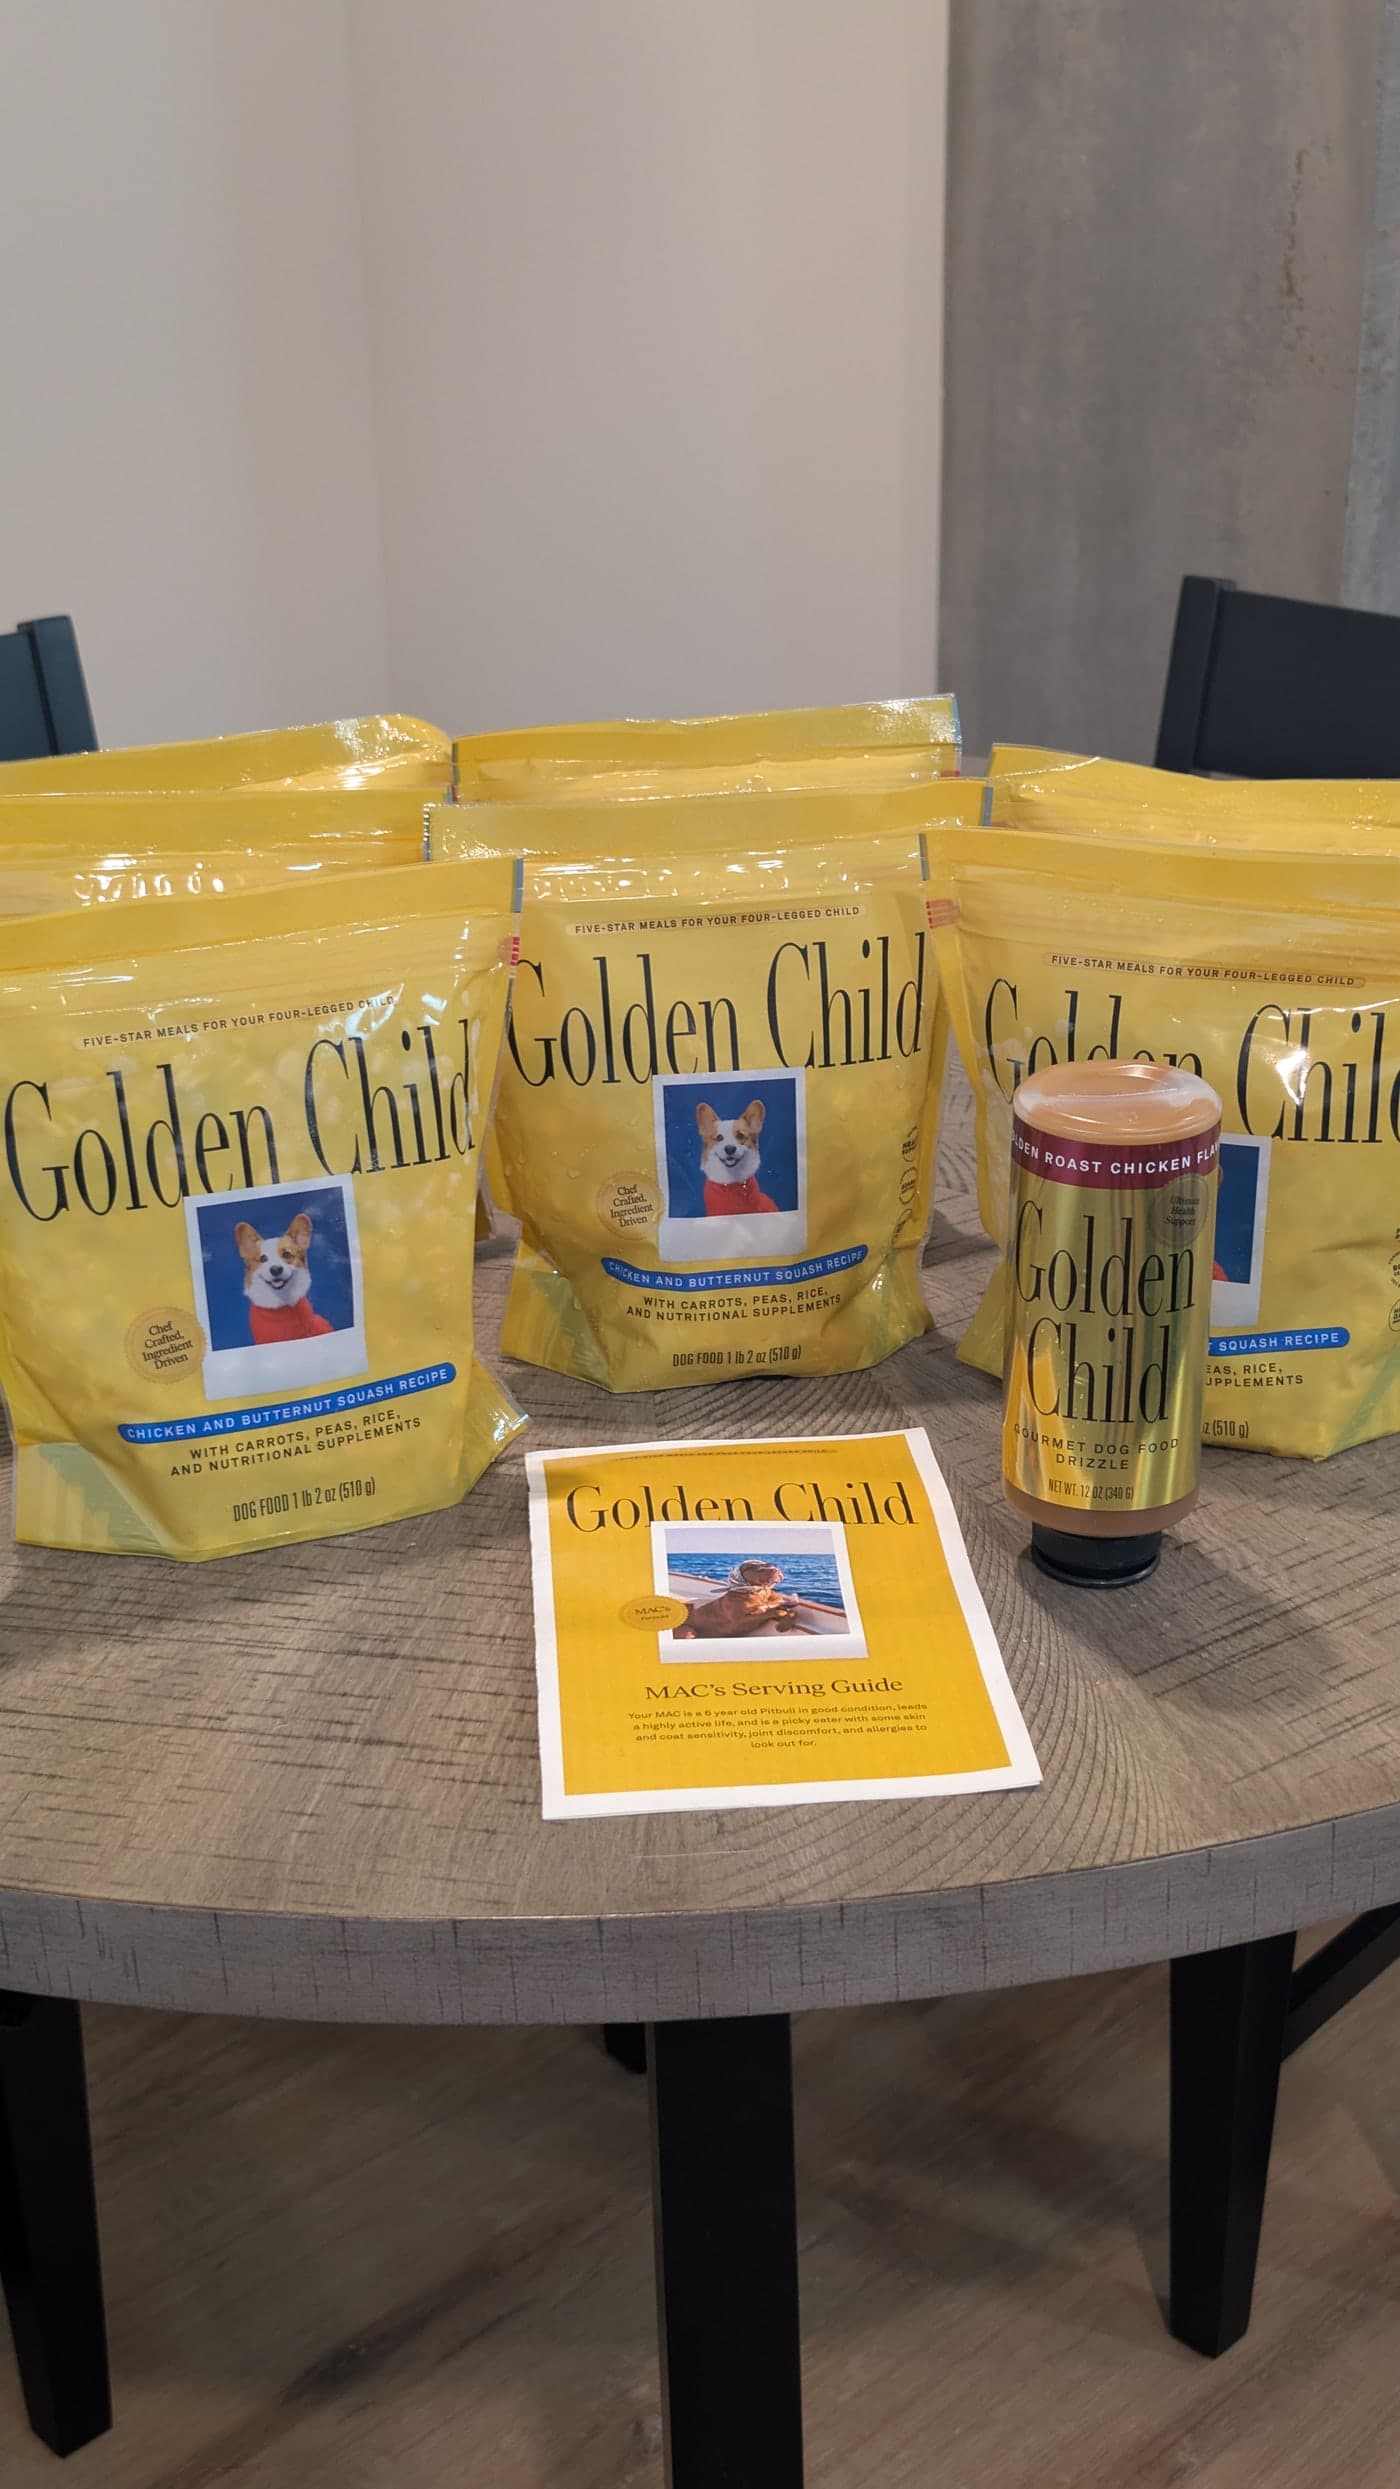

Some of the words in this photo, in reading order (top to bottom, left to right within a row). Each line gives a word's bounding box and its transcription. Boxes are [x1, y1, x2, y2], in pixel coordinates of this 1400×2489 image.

[576, 922, 635, 934] FIVE-STAR
[640, 920, 677, 929] MEALS
[682, 918, 702, 926] FOR
[707, 915, 736, 925] YOUR
[741, 910, 820, 922] FOUR-LEGGED
[826, 906, 859, 916] CHILD
[1052, 955, 1112, 969] FIVE-STAR
[1118, 962, 1154, 973] MEALS
[1160, 966, 1182, 976] FOR
[1188, 968, 1219, 978] YOUR
[1224, 970, 1312, 983] FOUR-LEGGED
[1317, 976, 1354, 985] CHILD
[507, 954, 739, 1086] Golden
[767, 932, 925, 1069] Child
[83, 1030, 152, 1047] FIVE-STAR
[157, 1024, 198, 1037] MEALS
[203, 1020, 226, 1031] FOR
[231, 1015, 264, 1027] YOUR
[269, 1003, 353, 1022] FOUR-LEGGED
[1237, 1004, 1400, 1143] Chil
[5, 1064, 280, 1221] Golden
[305, 1019, 475, 1175] Child
[1013, 1133, 1039, 1159] LDEN
[1045, 1152, 1101, 1173] ROAST
[1111, 1157, 1191, 1174] CHICKEN
[618, 1184, 637, 1195] Chef
[610, 1204, 653, 1218] Ingredient
[619, 1216, 647, 1227] Driven
[609, 1262, 649, 1283] CHICKEN
[656, 1276, 683, 1287] AND
[689, 1272, 769, 1287] BUTTERNUT
[776, 1263, 823, 1280] SQUASH
[827, 1250, 863, 1268] RECIPE
[1016, 1201, 1195, 1316] Golden
[627, 1306, 650, 1318] AND
[657, 1309, 747, 1322] NUTRITIONAL
[753, 1294, 841, 1317] SUPPLEMENTS
[644, 1296, 675, 1309] WITH
[682, 1297, 747, 1309] CARROTS,
[753, 1294, 791, 1305] PEAS,
[798, 1287, 827, 1300] RICE,
[149, 1321, 172, 1335] Chef
[142, 1340, 193, 1361] Ingredient
[1219, 1337, 1277, 1351] SQUASH
[1285, 1333, 1339, 1345] RECIPE
[154, 1354, 188, 1369] Driven
[673, 1353, 693, 1367] DOG
[697, 1352, 722, 1364] FOOD
[727, 1351, 732, 1363] 1
[735, 1351, 744, 1363] lb
[747, 1351, 753, 1363] 2
[756, 1354, 766, 1363] oz
[769, 1347, 789, 1363] (510
[792, 1345, 801, 1360] g)
[1028, 1317, 1169, 1423] Child
[1206, 1365, 1236, 1376] EAS,
[1243, 1363, 1282, 1374] RICE,
[1206, 1375, 1303, 1387] UPPLEMENTS
[128, 1424, 196, 1439] CHICKEN
[203, 1418, 234, 1431] AND
[242, 1400, 332, 1424] BUTTERNUT
[337, 1384, 393, 1406] SQUASH
[400, 1369, 447, 1390] RECIPE
[191, 1446, 229, 1459] WITH
[236, 1431, 310, 1453] CARROTS,
[316, 1420, 357, 1437] PEAS,
[364, 1409, 400, 1425] RICE,
[1015, 1424, 1085, 1452] GOURMET
[1095, 1444, 1129, 1454] DOG
[1138, 1439, 1178, 1453] FOOD
[1213, 1420, 1235, 1436] (510
[1239, 1421, 1248, 1438] g)
[171, 1464, 202, 1476] AND
[210, 1445, 311, 1471] NUTRITIONAL
[318, 1417, 421, 1451] SUPPLEMENTS
[1056, 1454, 1129, 1469] DRIZZLE
[234, 1501, 256, 1521] DOG
[260, 1495, 289, 1516] FOOD
[292, 1493, 298, 1509] 1
[302, 1490, 312, 1507] lb
[315, 1488, 322, 1505] 2
[325, 1489, 336, 1502] oz
[339, 1480, 362, 1502] (510
[364, 1477, 375, 1496] g)
[1049, 1478, 1063, 1493] NET
[1064, 1482, 1078, 1496] WT.
[1081, 1485, 1090, 1497] 12
[1092, 1486, 1102, 1498] OZ
[1105, 1487, 1123, 1500] (340
[1125, 1486, 1134, 1500] G)
[567, 1485, 753, 1532] Golden
[774, 1482, 918, 1526] Child
[733, 1682, 826, 1697] Serving
[832, 1678, 903, 1694] Guide
[683, 1710, 692, 1718] is
[713, 1710, 738, 1719] year
[760, 1706, 795, 1714] Pitbull
[811, 1706, 837, 1714] good
[841, 1704, 896, 1712] condition,
[643, 1722, 676, 1730] highly
[678, 1720, 712, 1728] active
[714, 1719, 735, 1727] life,
[782, 1716, 810, 1726] picky
[688, 1730, 746, 1740] sensitivity,
[748, 1730, 772, 1738] joint
[776, 1727, 840, 1737] discomfort,
[843, 1726, 863, 1734] and
[866, 1724, 912, 1733] allergies
[751, 1740, 774, 1748] look
